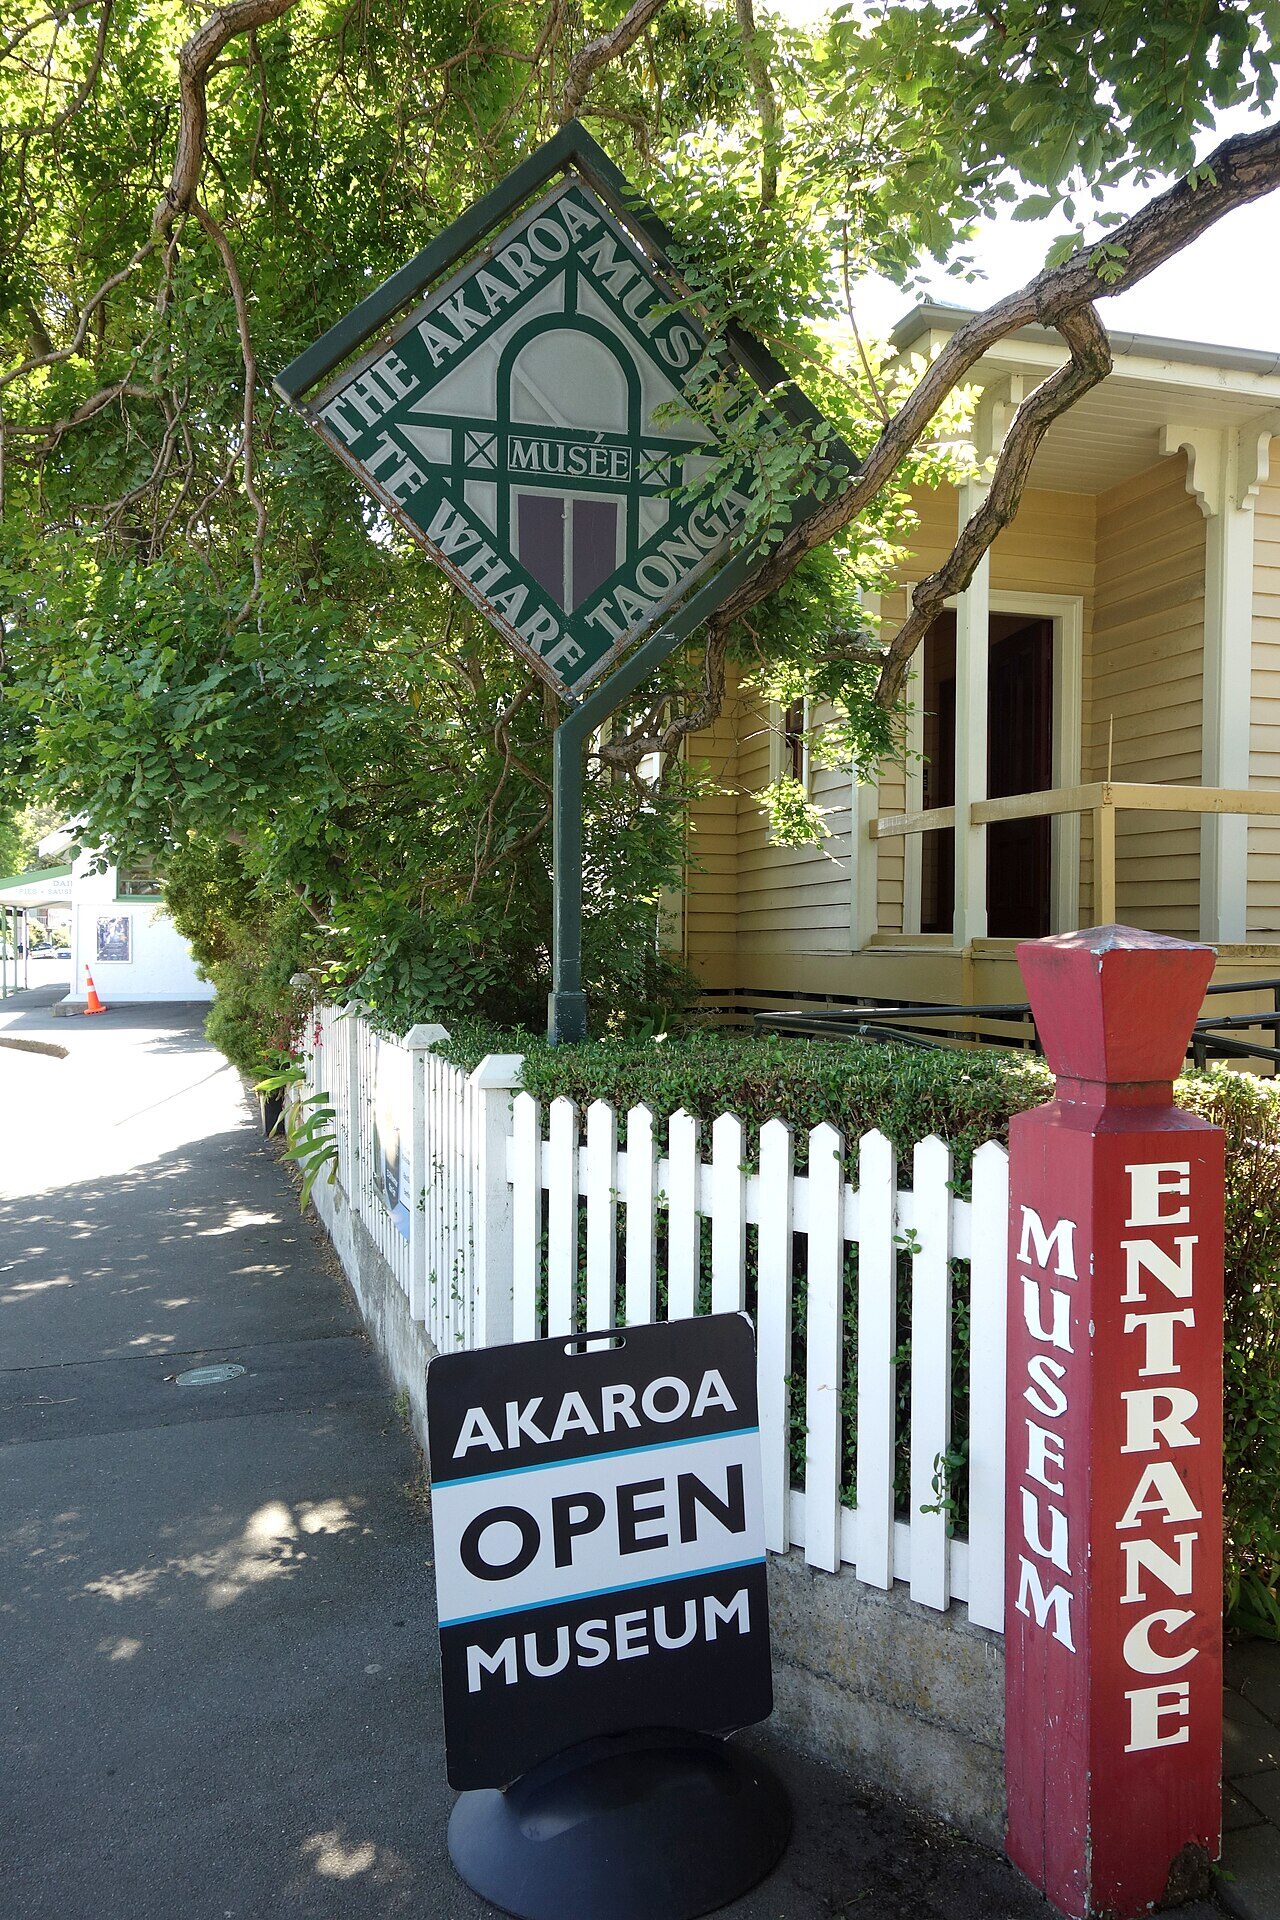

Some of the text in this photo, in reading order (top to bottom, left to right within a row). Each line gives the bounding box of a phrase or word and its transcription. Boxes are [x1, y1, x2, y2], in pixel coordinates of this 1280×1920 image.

[317, 197, 601, 445] THE AKAROA
[509, 434, 629, 479] MUSÉE
[361, 430, 586, 678] TE WHARE
[584, 489, 753, 643] TAONGA
[453, 1369, 737, 1458] AKAROA
[1015, 1204, 1078, 1653] MUSEUM
[1116, 1161, 1202, 1753] ENTRANCE
[460, 1463, 747, 1582] OPEN
[466, 1588, 751, 1693] MUSEUM
